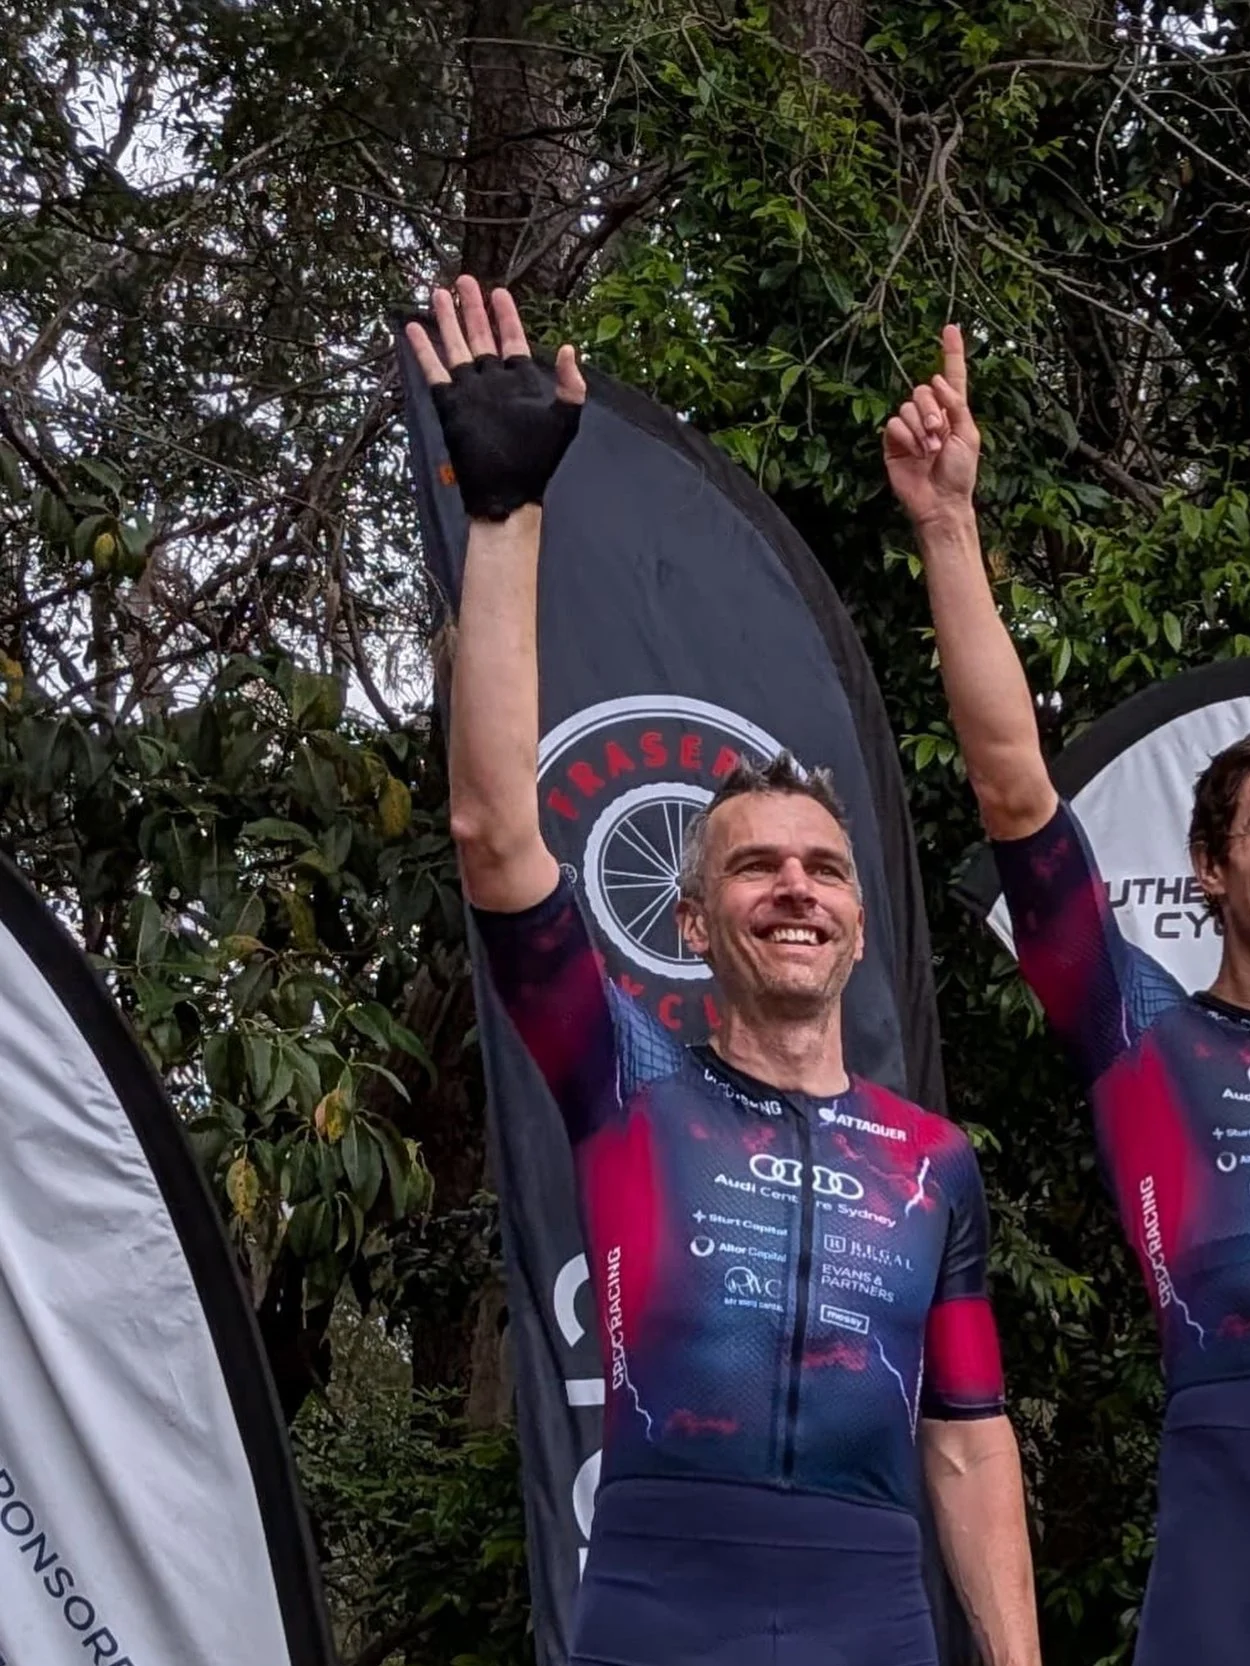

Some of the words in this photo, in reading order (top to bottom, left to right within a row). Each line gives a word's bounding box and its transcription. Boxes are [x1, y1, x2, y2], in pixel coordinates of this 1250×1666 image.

[1103, 876, 1205, 908] UTHE
[836, 1113, 907, 1142] ATTAQUER
[714, 1173, 756, 1193] Audi
[837, 1204, 897, 1228] Sydney
[822, 1263, 872, 1283] EVANS
[821, 1275, 895, 1303] PARTNERS
